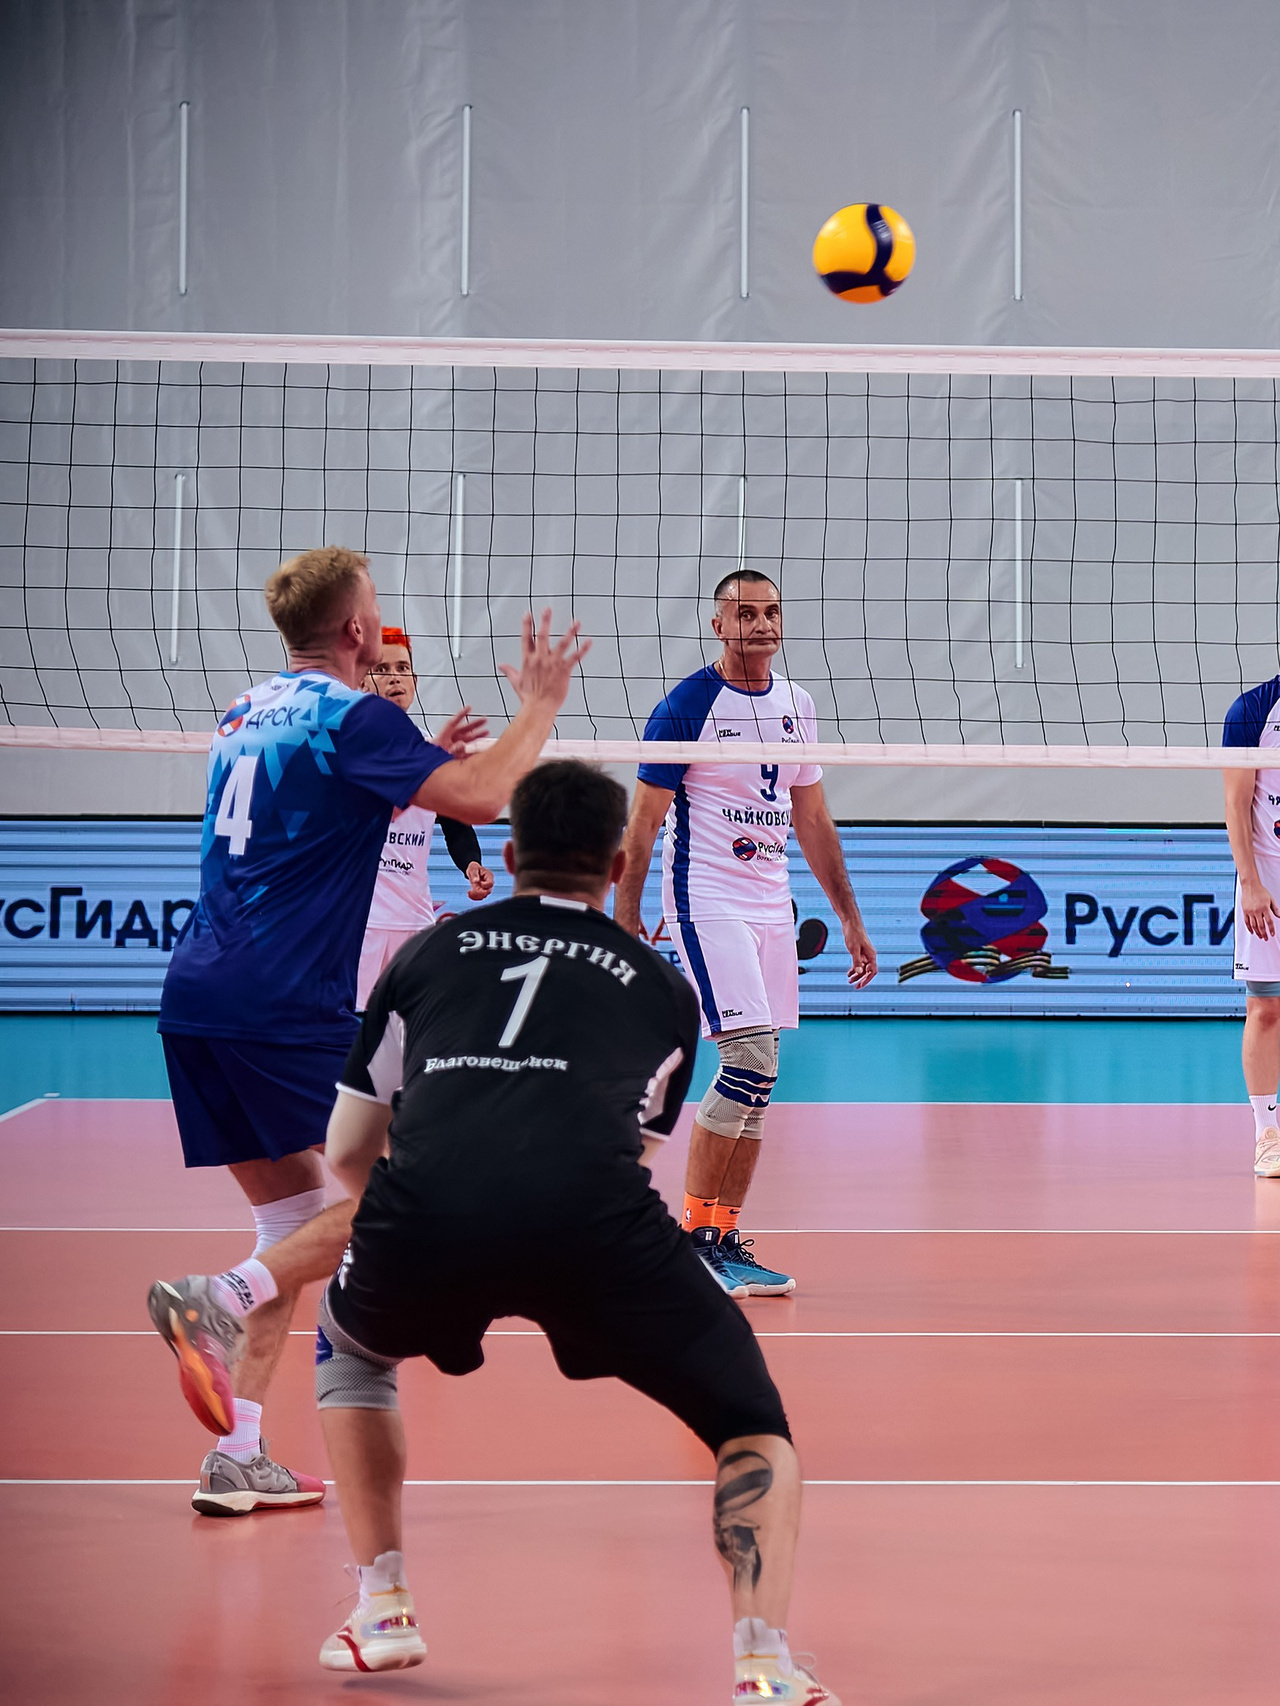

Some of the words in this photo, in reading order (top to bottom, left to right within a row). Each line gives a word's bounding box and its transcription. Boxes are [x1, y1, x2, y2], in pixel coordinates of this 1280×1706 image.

[246, 706, 302, 730] ДРСК
[214, 755, 259, 856] 4
[760, 764, 779, 802] 9
[498, 955, 550, 1048] 1
